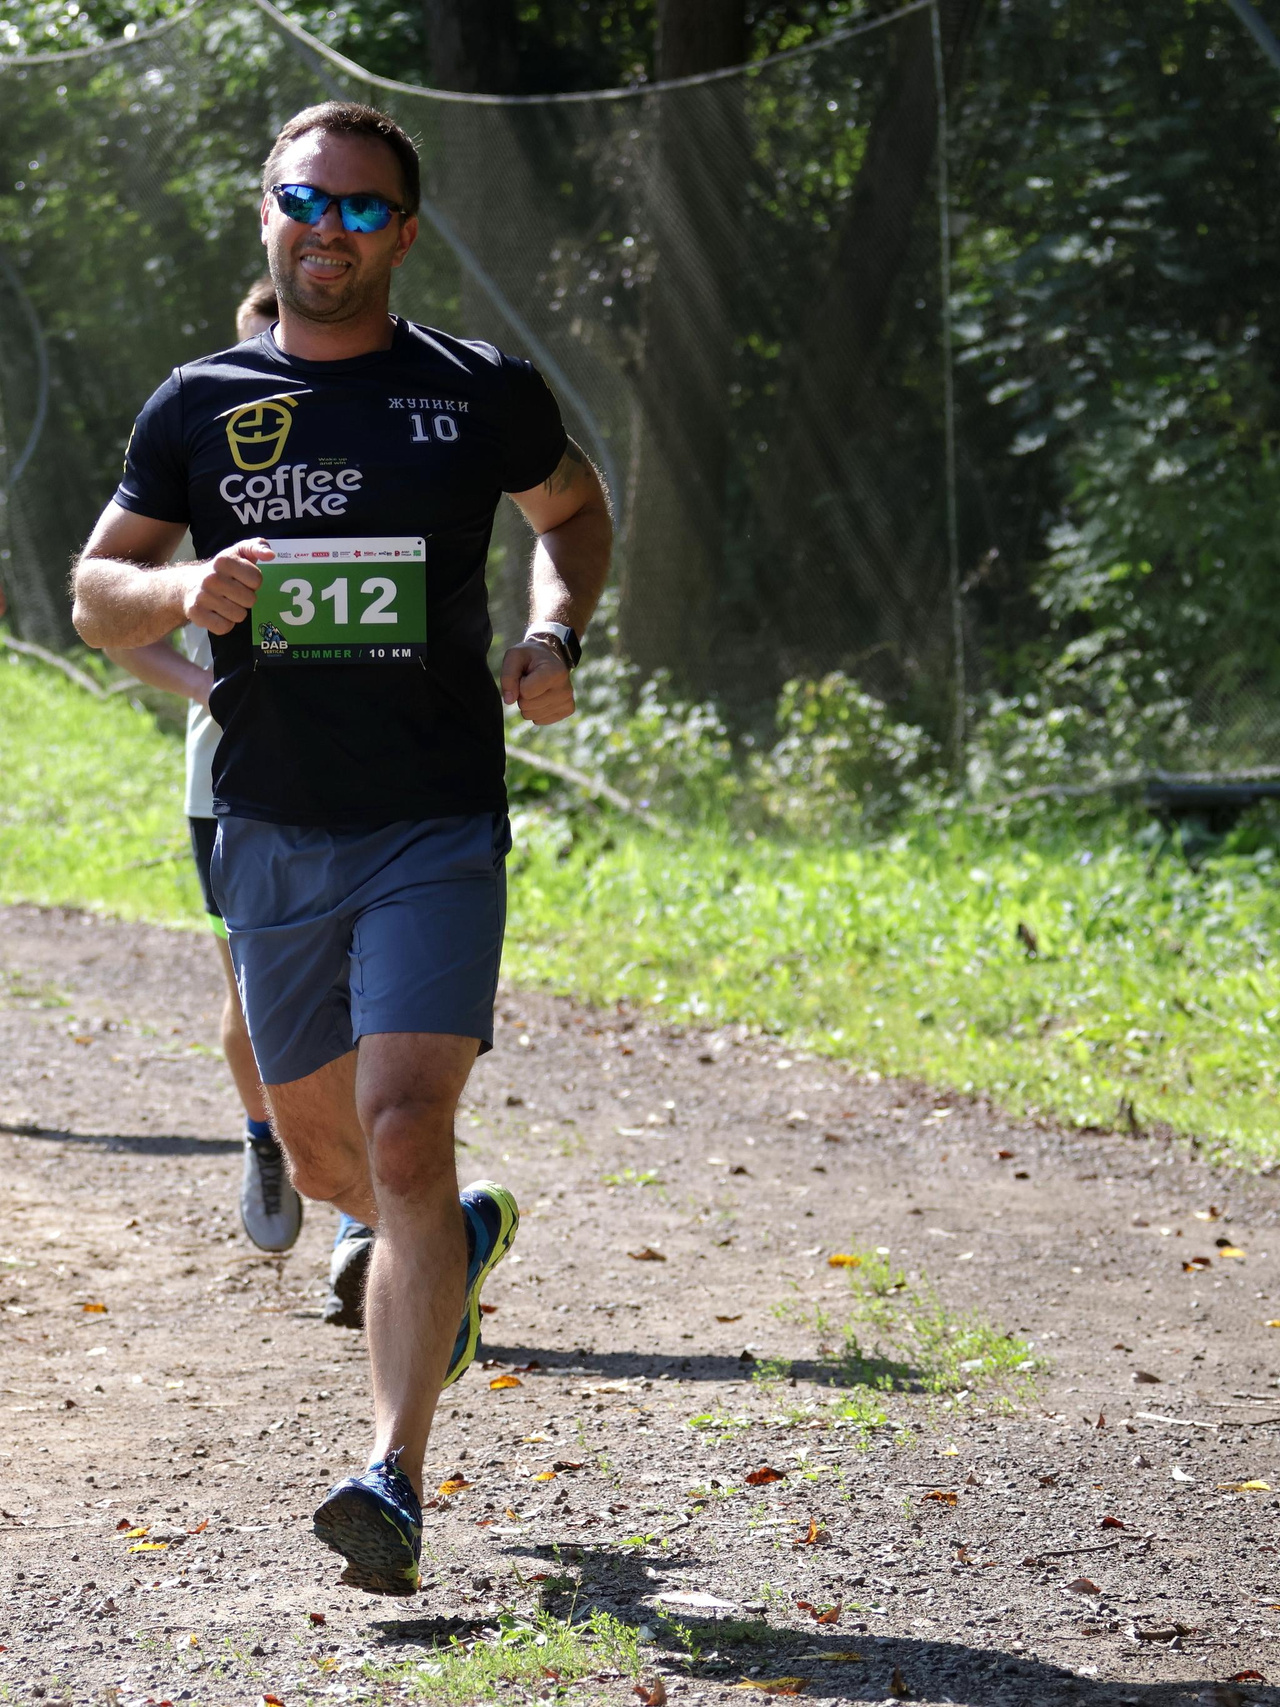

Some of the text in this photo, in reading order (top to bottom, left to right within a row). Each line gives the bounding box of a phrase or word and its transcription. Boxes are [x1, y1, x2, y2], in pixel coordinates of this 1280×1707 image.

[388, 398, 469, 413] ЖУЛИКИ
[409, 412, 460, 443] 10
[279, 577, 398, 626] 312
[261, 640, 289, 650] DAB
[292, 650, 352, 659] SUMMER
[369, 648, 385, 658] 10
[392, 648, 412, 658] KM
